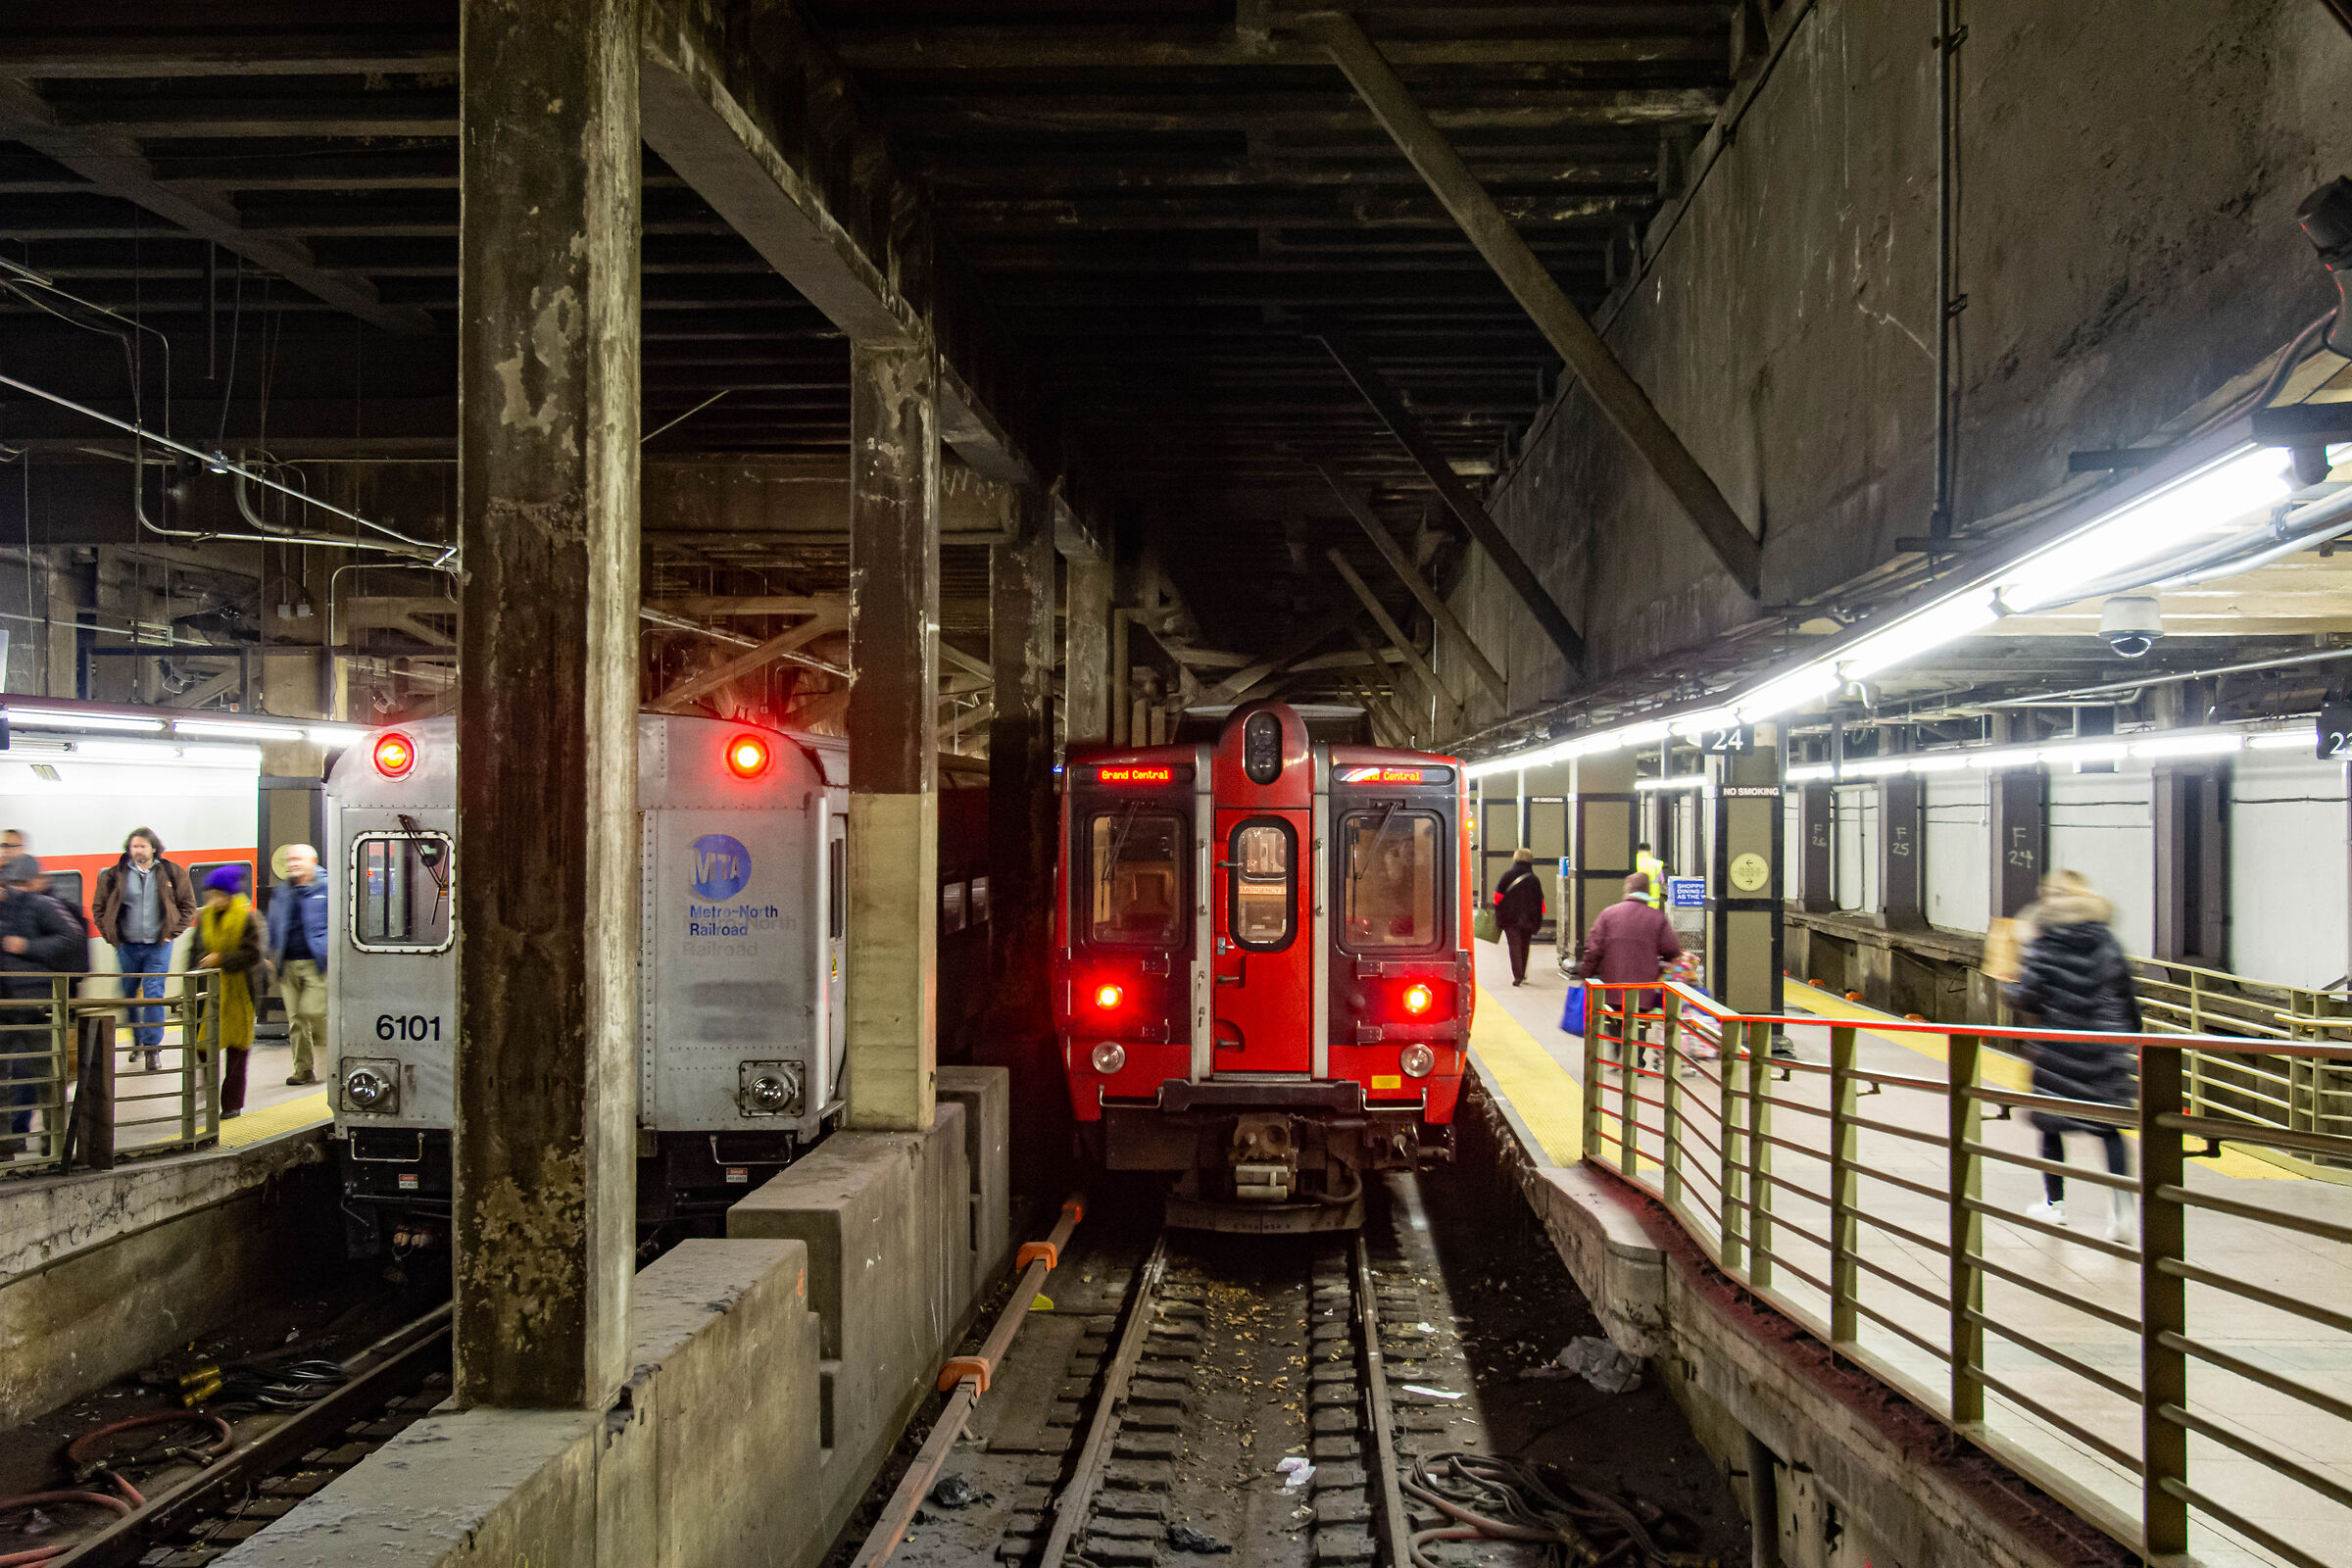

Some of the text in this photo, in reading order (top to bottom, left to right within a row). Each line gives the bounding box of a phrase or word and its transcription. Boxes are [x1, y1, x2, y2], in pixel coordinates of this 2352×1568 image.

[1711, 728, 1744, 751] 24
[1102, 769, 1169, 780] Grand Central
[1383, 771, 1420, 782] Central
[1723, 787, 1780, 796] NO SMOKING
[1896, 826, 1907, 840] F
[2012, 826, 2027, 848] F
[1892, 842, 1910, 857] 25
[2008, 850, 2034, 869] 24
[690, 905, 778, 918] Metro-North
[690, 922, 748, 936] Railroad
[375, 1013, 440, 1042] 6101
